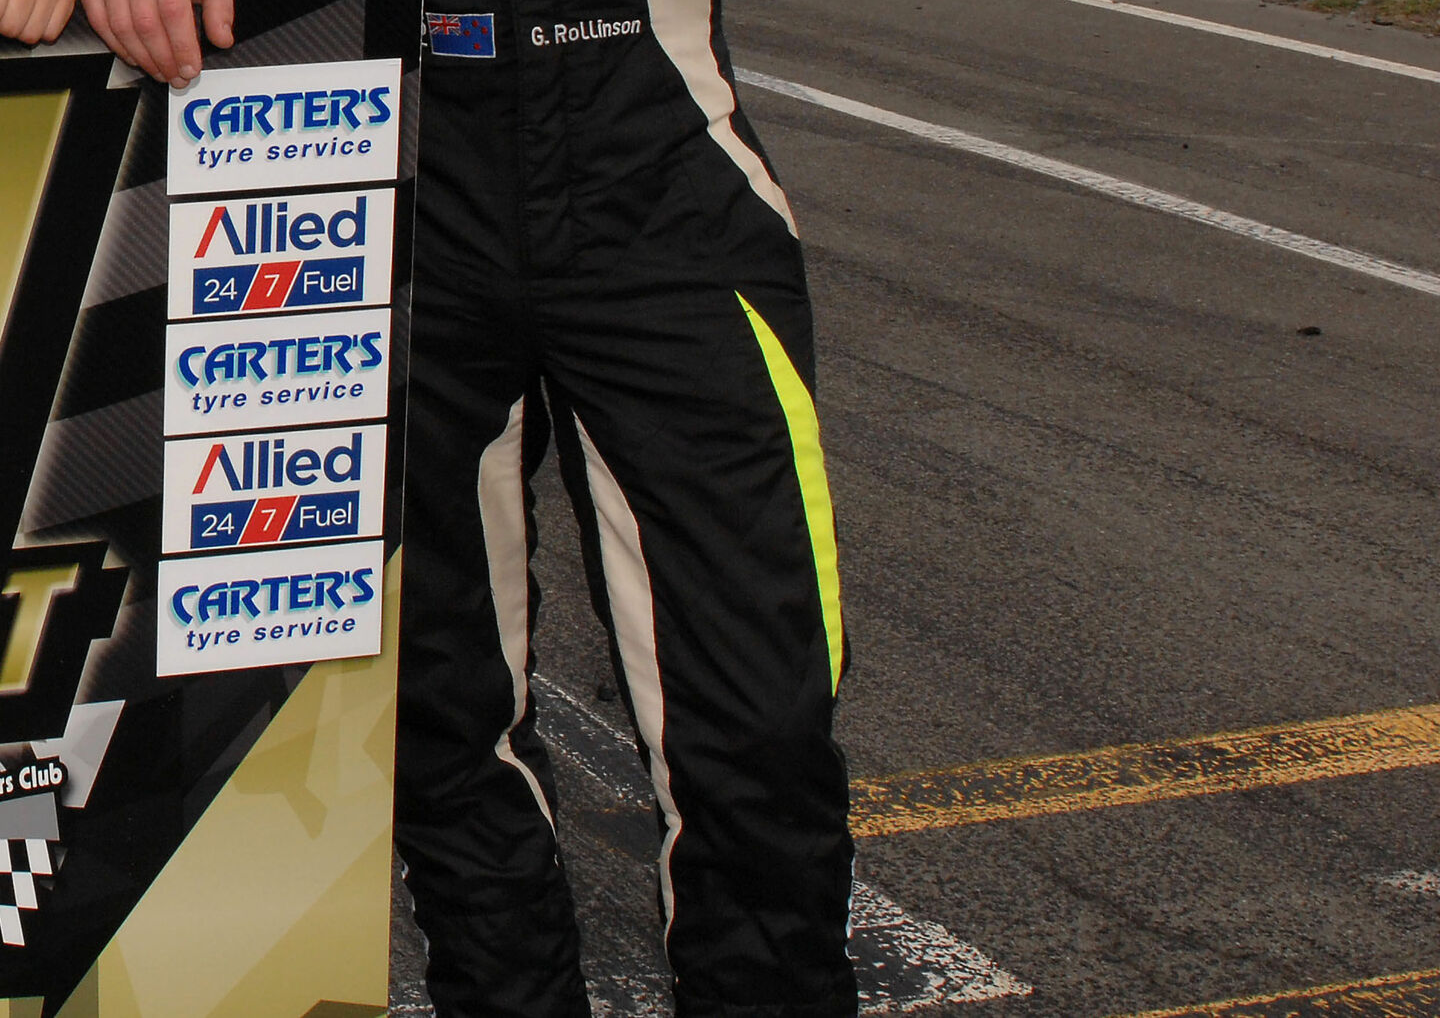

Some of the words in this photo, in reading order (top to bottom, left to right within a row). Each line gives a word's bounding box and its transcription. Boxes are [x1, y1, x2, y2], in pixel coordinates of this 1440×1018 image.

[531, 26, 550, 46] G.
[554, 19, 642, 44] Rollinson
[182, 86, 391, 141] CARTER'S
[197, 146, 253, 169] tyre
[266, 137, 372, 160] service
[194, 196, 367, 259] Allied
[203, 276, 238, 303] 24
[263, 273, 280, 298] 7
[303, 268, 357, 295] Fuel
[178, 331, 382, 388] CARTER'S
[192, 392, 247, 414] tyre
[260, 381, 364, 406] service
[192, 432, 363, 495] Allied
[201, 513, 235, 538] 24
[261, 509, 277, 533] 7
[299, 502, 353, 530] Fuel
[171, 567, 375, 626] CARTER'S
[186, 629, 241, 651] tyre
[253, 617, 356, 642] service
[18, 762, 64, 790] Club
